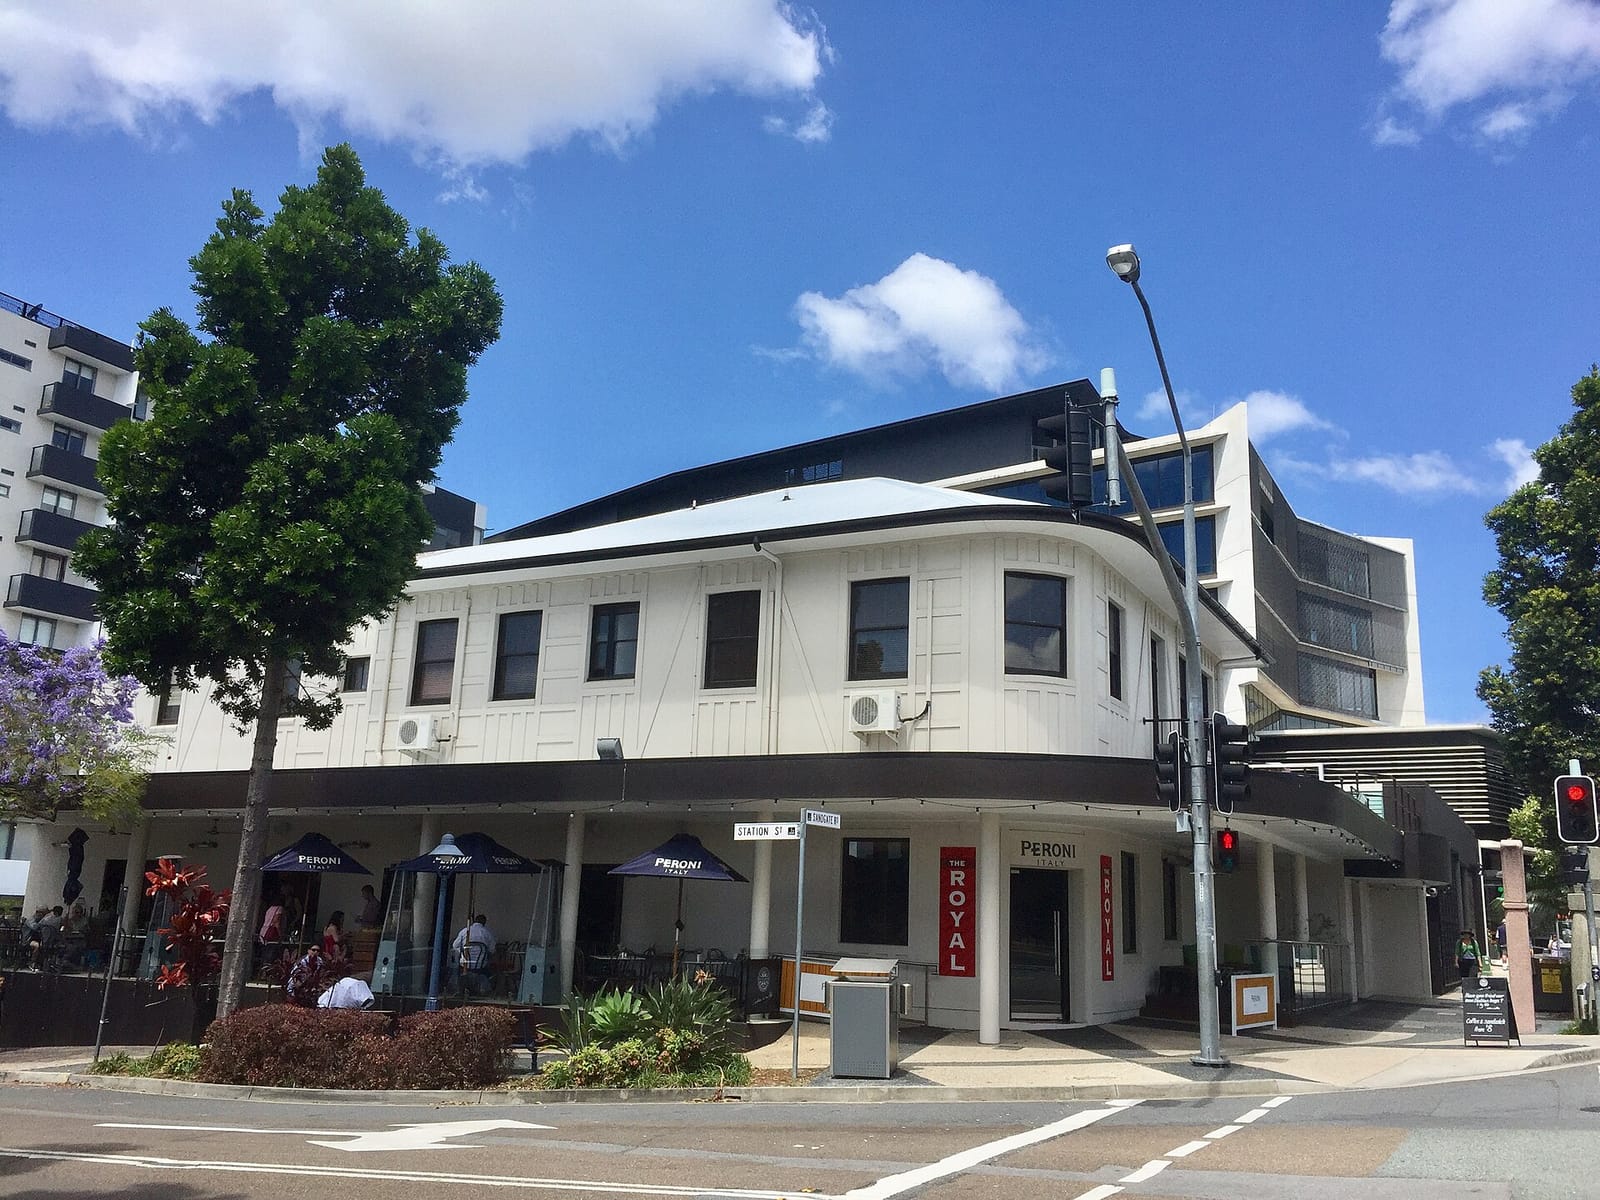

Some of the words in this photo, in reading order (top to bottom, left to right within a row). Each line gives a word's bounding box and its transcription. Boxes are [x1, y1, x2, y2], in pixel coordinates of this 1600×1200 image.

[812, 812, 834, 825] SANDGATE
[737, 826, 769, 836] STATION
[1020, 840, 1076, 859] PERONI
[298, 855, 341, 865] PERONI
[654, 857, 702, 869] PERONI
[1036, 859, 1065, 867] ITALY
[949, 870, 966, 971] ROYAL
[1104, 879, 1112, 976] ROYAL
